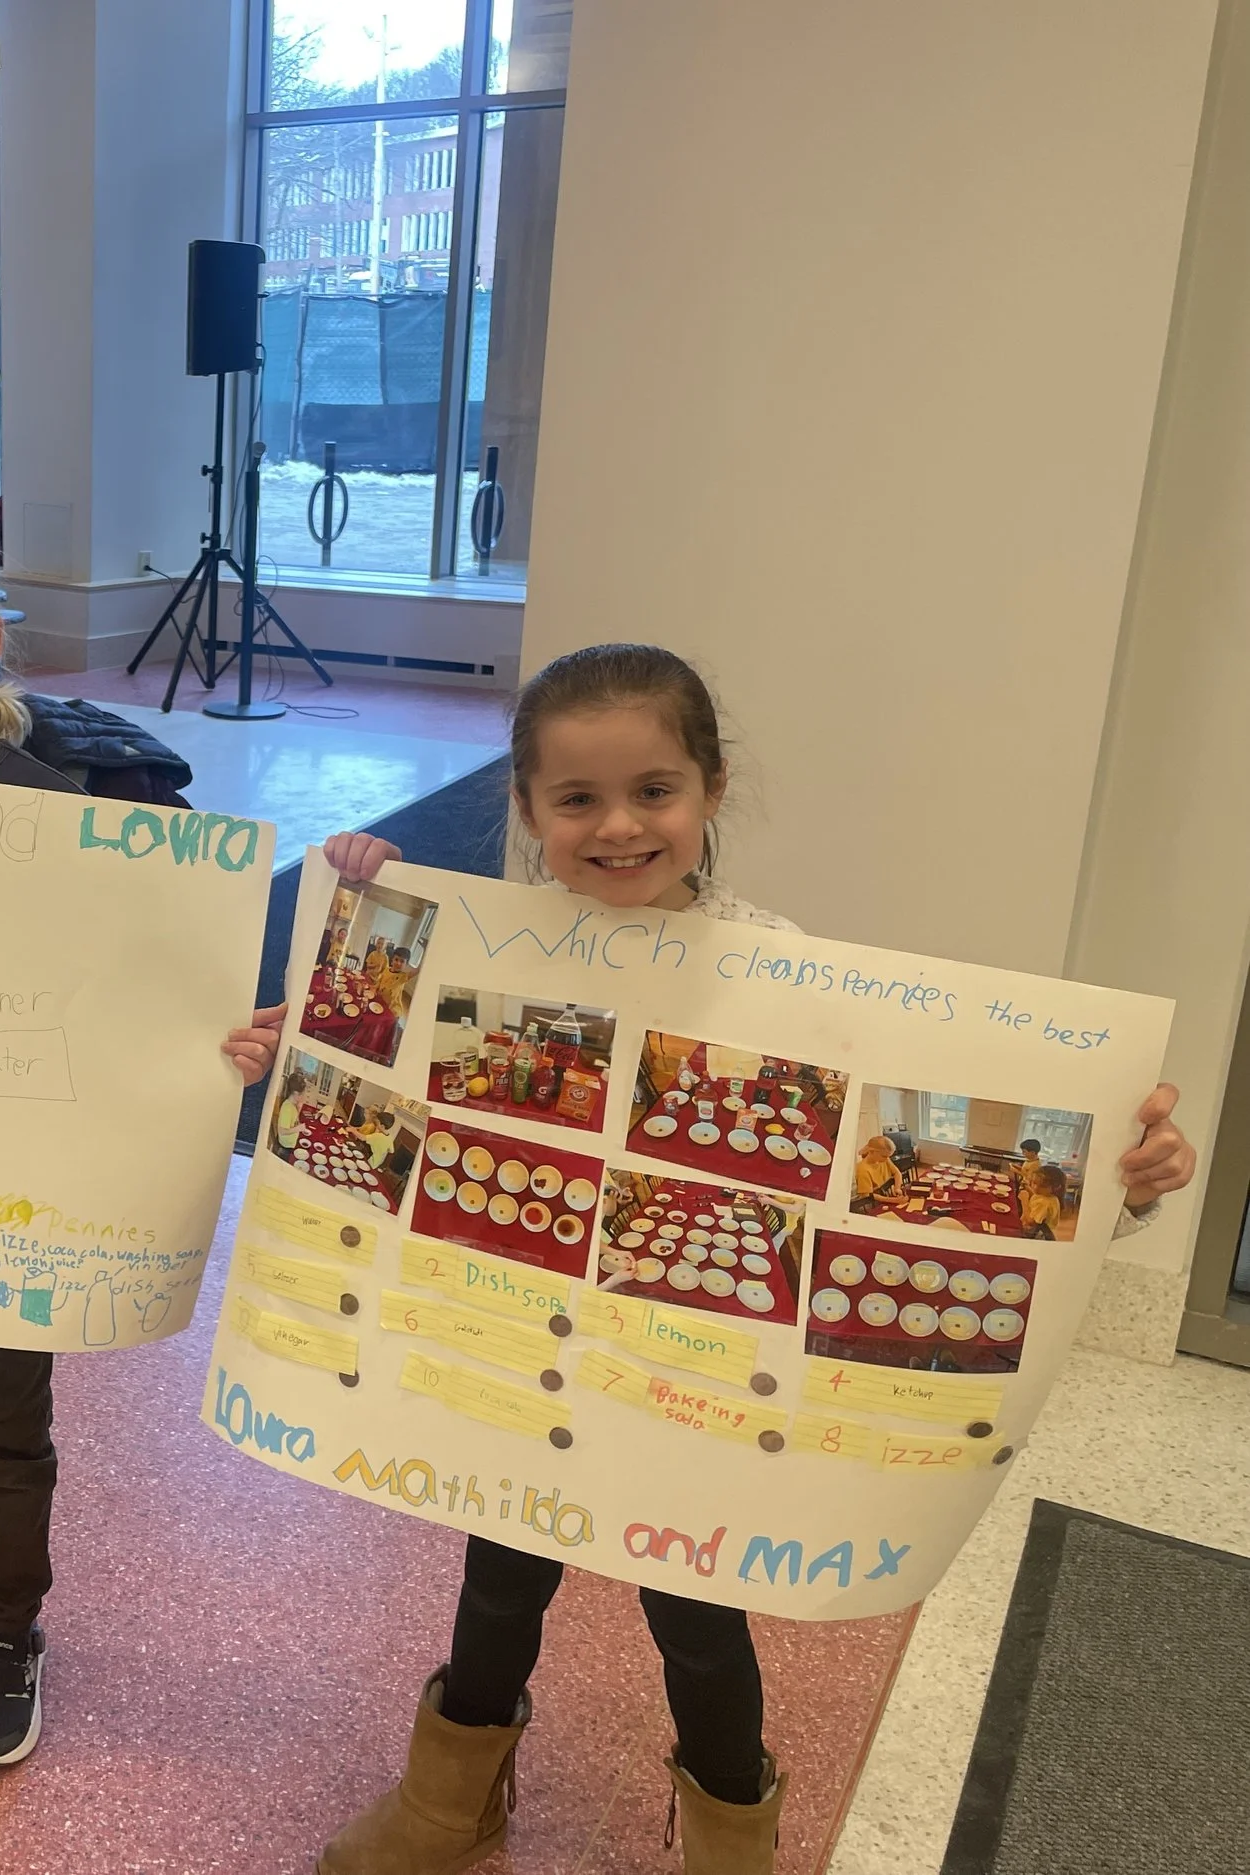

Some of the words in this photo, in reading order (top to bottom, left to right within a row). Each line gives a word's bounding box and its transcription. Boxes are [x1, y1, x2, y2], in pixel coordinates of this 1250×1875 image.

[459, 895, 686, 968] Which
[985, 997, 1033, 1032] the
[1043, 1019, 1112, 1050] best
[425, 1257, 446, 1278] 2
[466, 1261, 516, 1297] Dish
[404, 1309, 419, 1332] 6
[605, 1305, 624, 1334] 3
[647, 1307, 726, 1356] lemon
[423, 1367, 440, 1387] 10
[828, 1369, 852, 1393] 4
[602, 1368, 624, 1392] 7
[656, 1385, 746, 1428] Bakeing
[665, 1407, 707, 1430] soda
[820, 1425, 842, 1453] 8
[881, 1438, 963, 1466] izze
[623, 1522, 728, 1578] and
[737, 1534, 912, 1588] MAX
